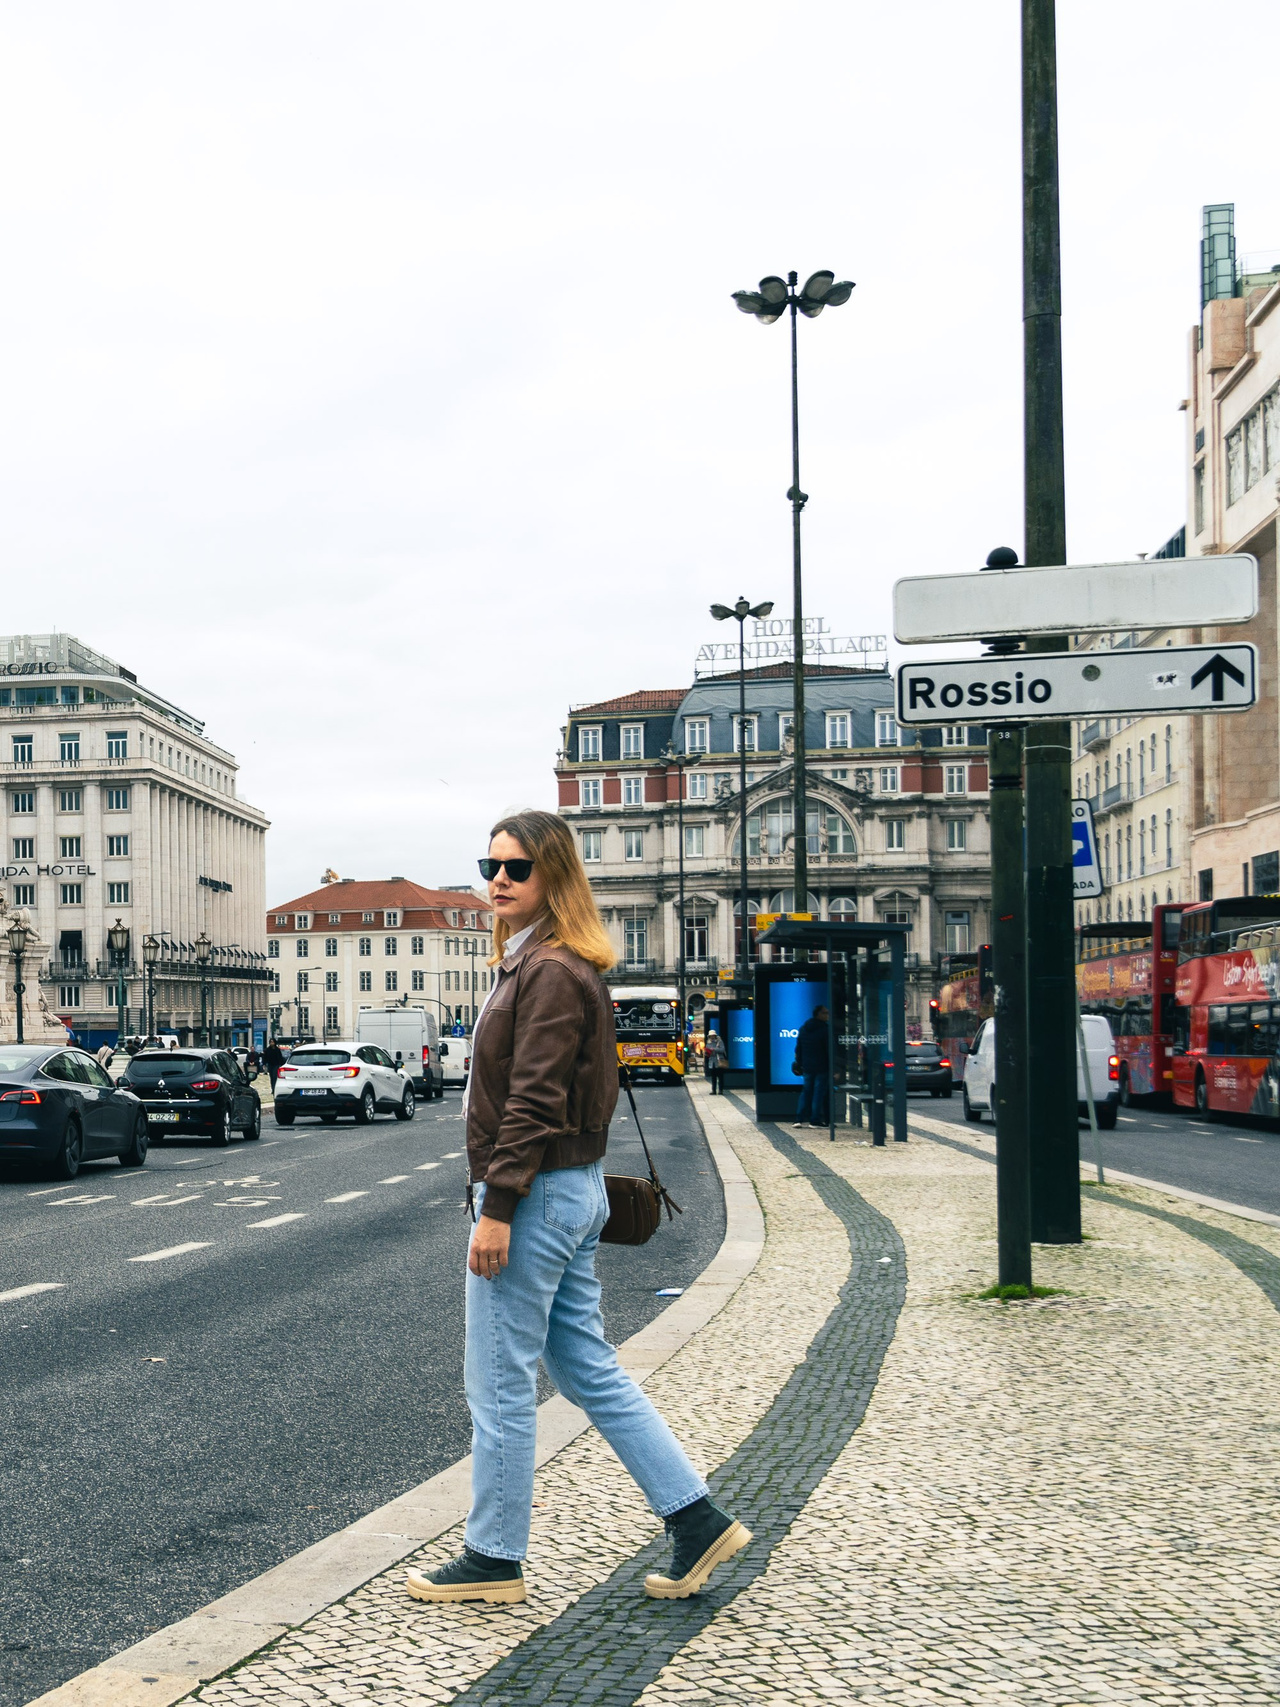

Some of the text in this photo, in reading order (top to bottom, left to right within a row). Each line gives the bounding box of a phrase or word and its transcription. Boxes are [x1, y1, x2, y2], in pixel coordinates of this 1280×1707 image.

[753, 617, 830, 637] HOTEL
[695, 635, 887, 661] AVENIDA PALACE
[909, 671, 1052, 710] Rossio
[998, 731, 1010, 739] 38
[37, 864, 96, 876] HOTEL
